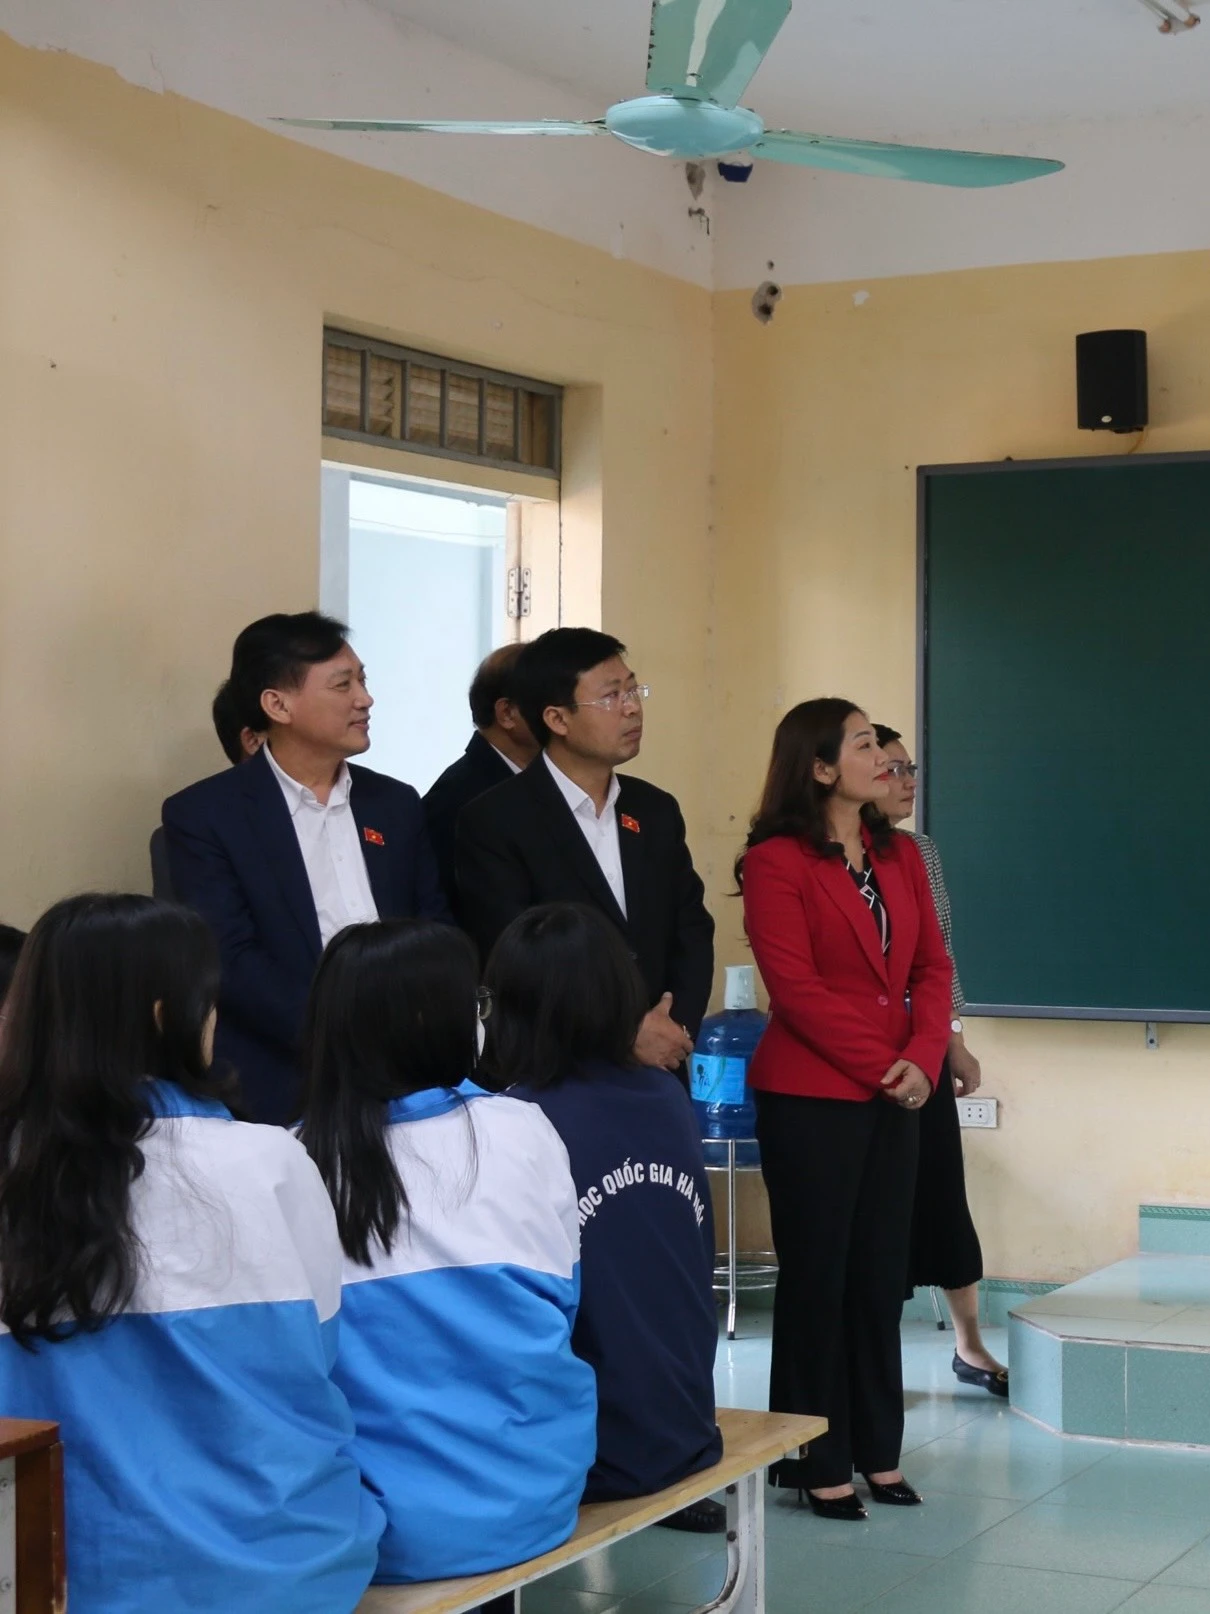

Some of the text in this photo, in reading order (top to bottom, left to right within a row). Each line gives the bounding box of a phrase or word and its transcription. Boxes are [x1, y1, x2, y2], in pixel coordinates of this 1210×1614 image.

[602, 1157, 645, 1195] QUỐC
[649, 1163, 673, 1186] GIA
[676, 1172, 694, 1200] HÀ
